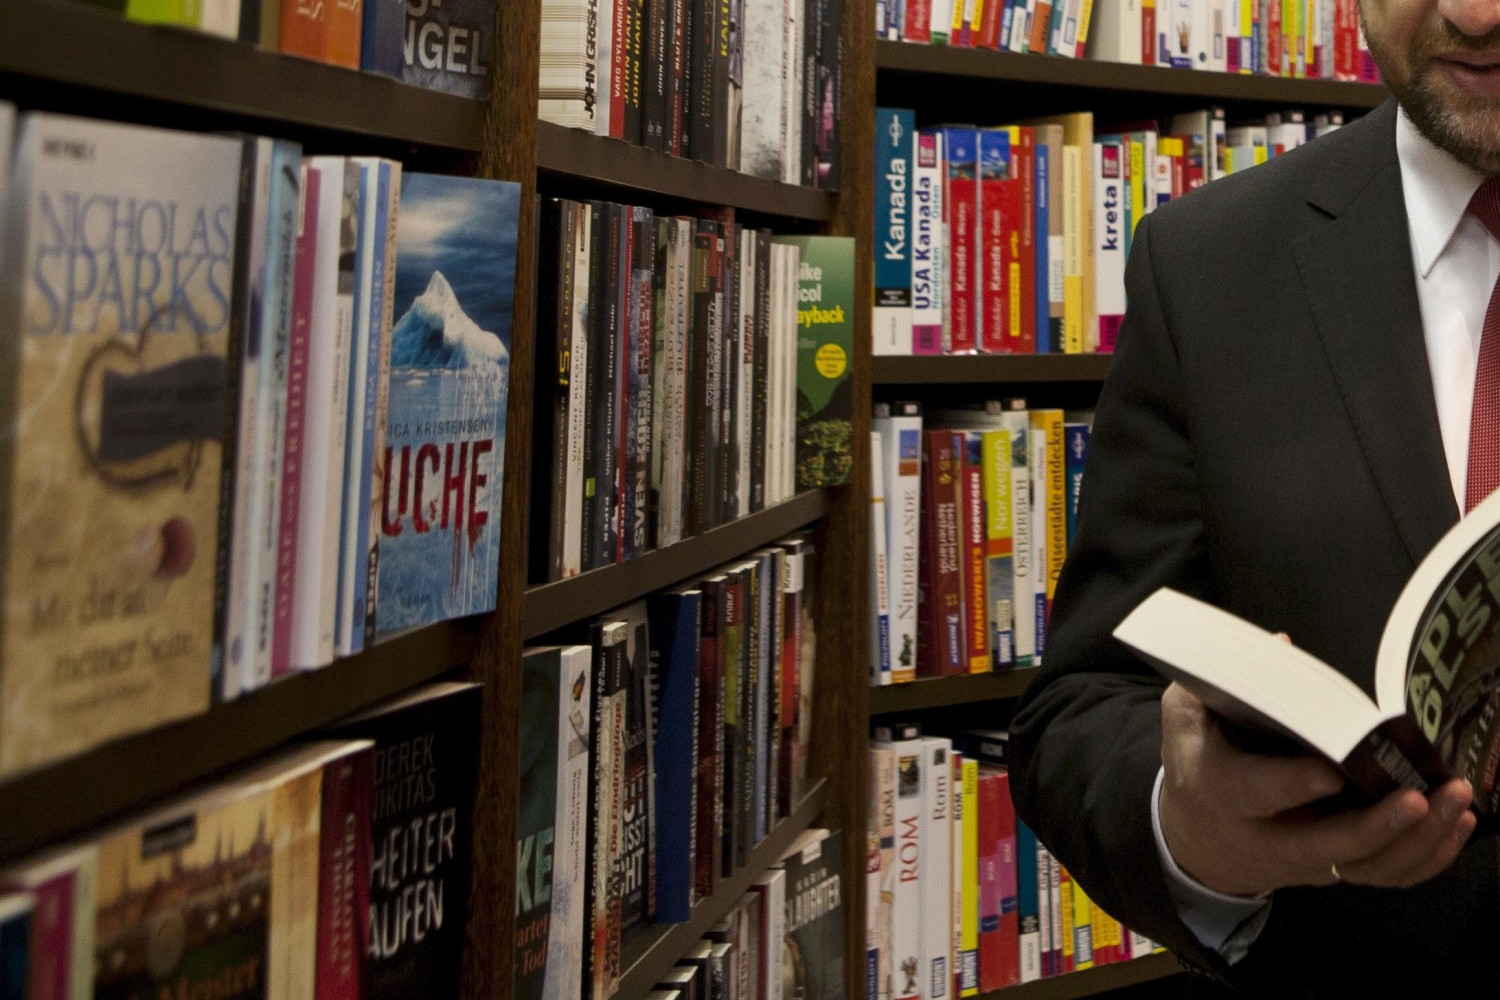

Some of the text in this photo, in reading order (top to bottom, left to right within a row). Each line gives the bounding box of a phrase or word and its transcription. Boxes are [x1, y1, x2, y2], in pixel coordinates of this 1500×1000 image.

[585, 63, 596, 119] JOHN
[40, 188, 231, 260] NICHOLAS
[885, 158, 908, 260] Kanada
[914, 177, 931, 309] USA Kanada
[1101, 185, 1118, 250] kreta
[34, 248, 231, 334] SPARKS
[798, 262, 823, 282] ike
[796, 305, 846, 329] ayback
[389, 417, 490, 438] ICA KRISTENSEN
[382, 439, 494, 540] UCHE
[634, 389, 647, 547] SVEN KOCH
[1049, 421, 1062, 580] Ostseestädte entdecken
[971, 472, 981, 544] NORWEGEN
[611, 702, 621, 820] Eindringlinge
[881, 789, 895, 826] ROM
[933, 776, 947, 820] Rom
[368, 808, 456, 890] HEITER
[899, 816, 919, 882] ROM
